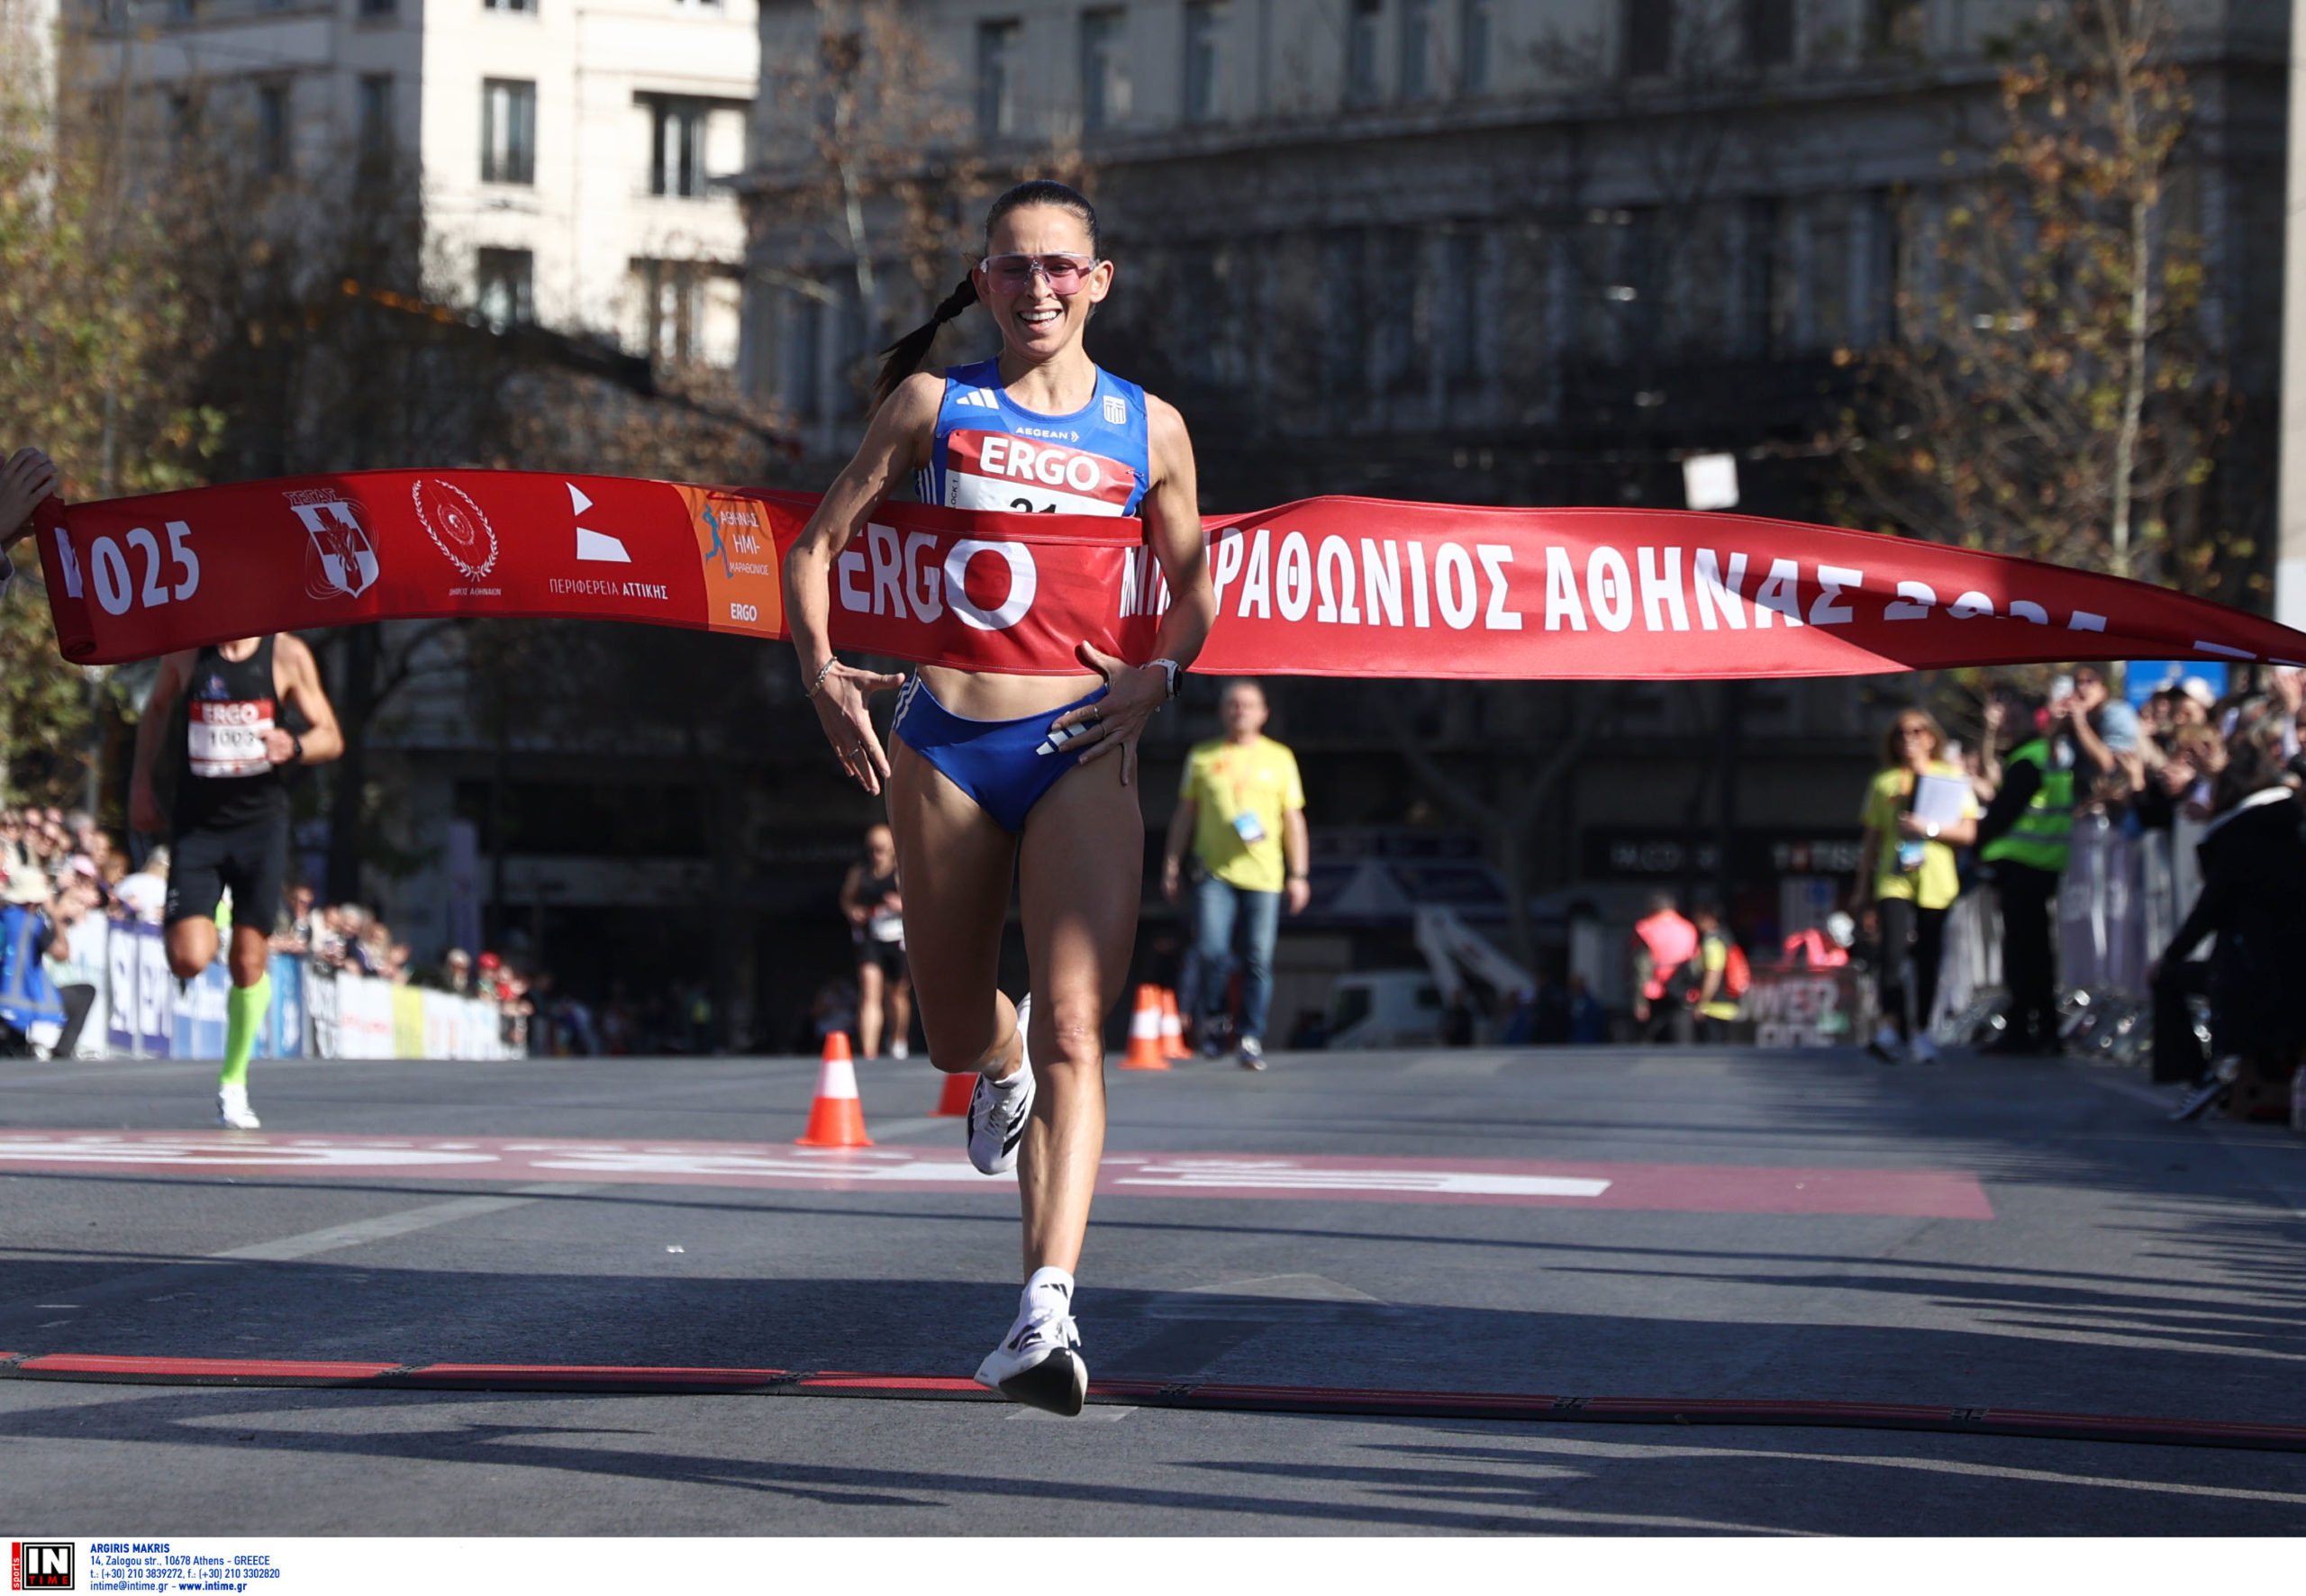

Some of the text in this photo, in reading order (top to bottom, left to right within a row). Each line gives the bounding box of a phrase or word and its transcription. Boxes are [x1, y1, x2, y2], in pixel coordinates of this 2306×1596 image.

[1015, 426, 1068, 440] AEGEAN
[979, 435, 1101, 492] ERGO
[950, 485, 958, 509] OCK
[720, 510, 759, 528] ΑΘΗΝΑΣ
[838, 521, 1038, 630] ERGO
[549, 578, 668, 600] ΠΕΡΙΦΕΡΕΙΑ ΑΤΤΙΚΗΣ
[1544, 545, 1864, 632] ΑΘΗΝΑΣ
[731, 603, 758, 622] ERGO
[202, 702, 259, 725] ERGO
